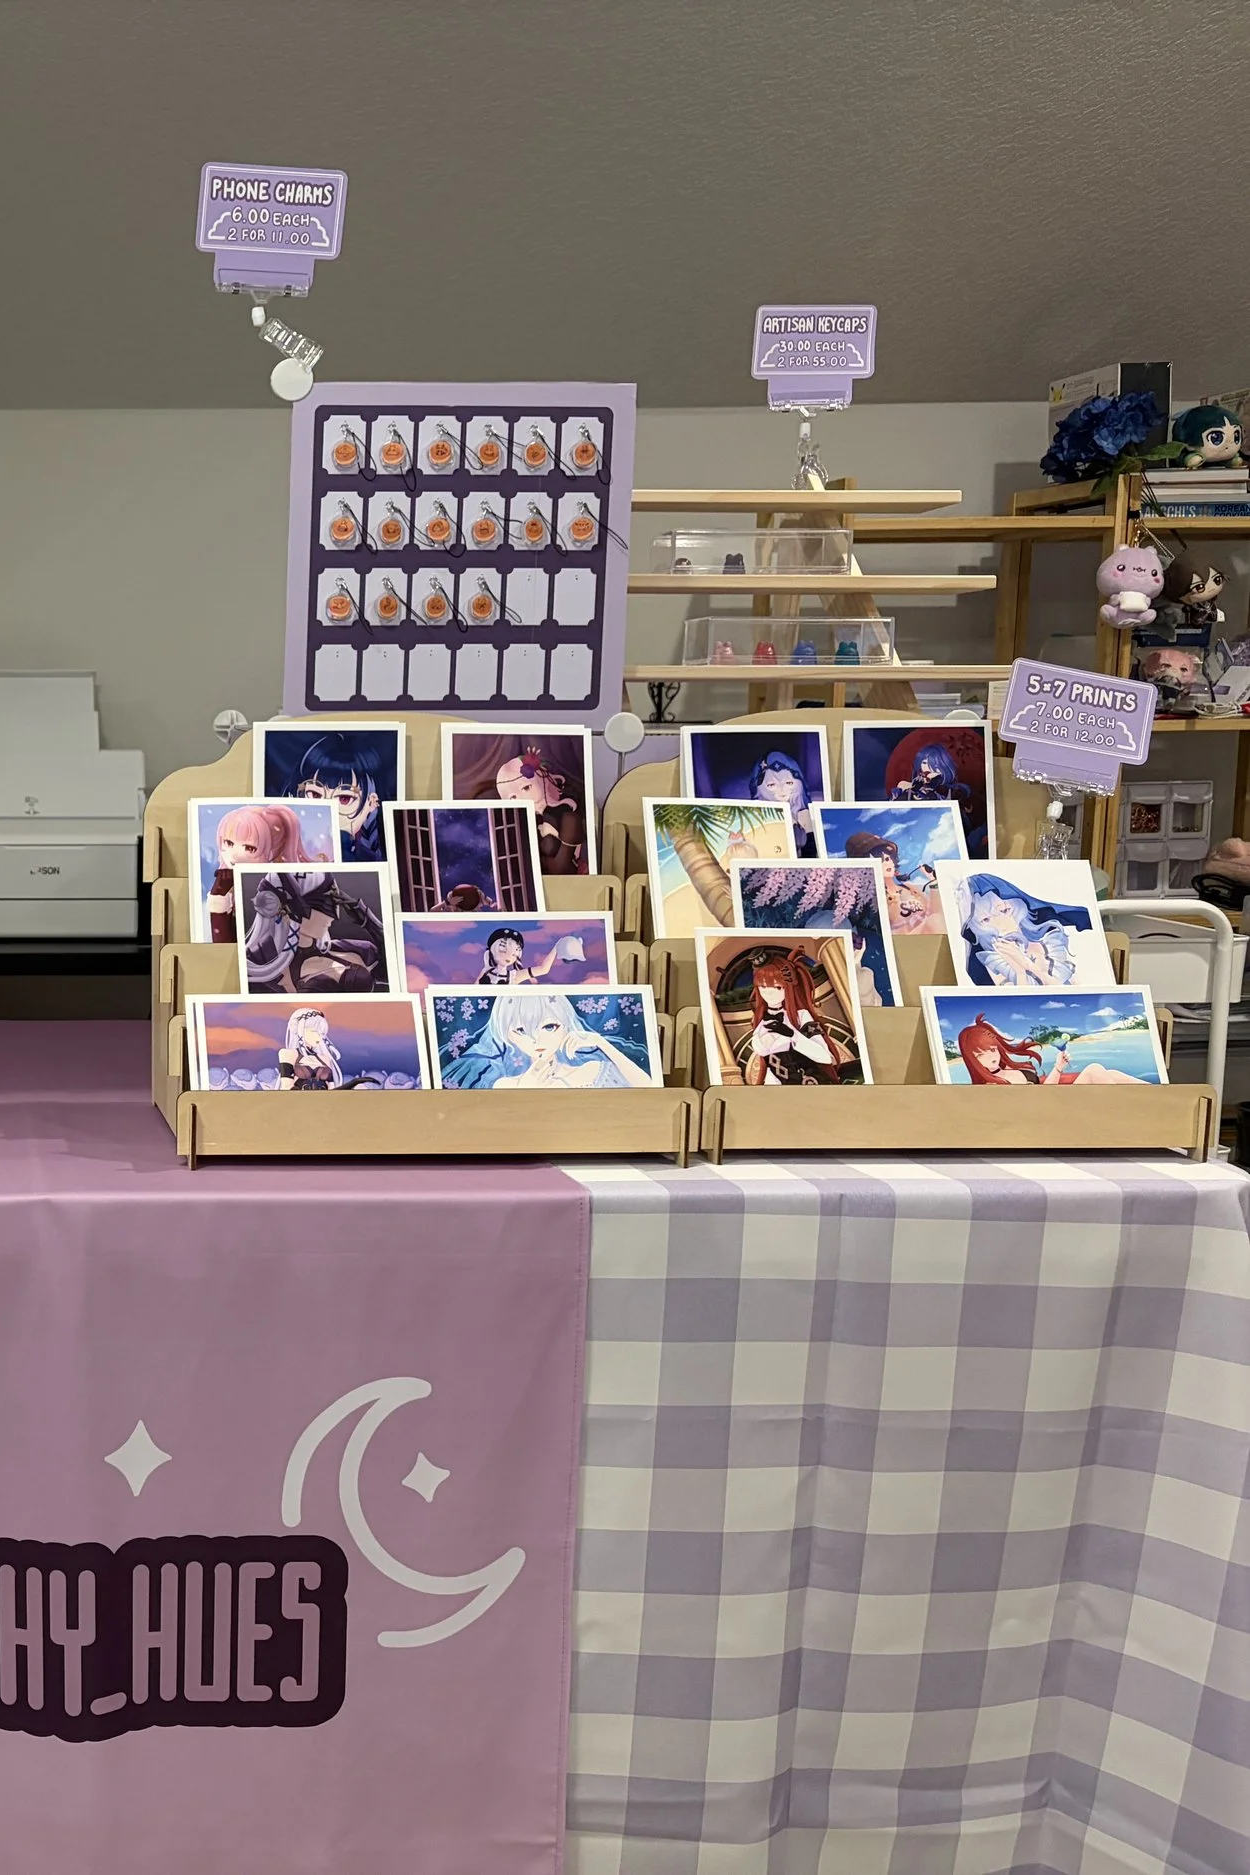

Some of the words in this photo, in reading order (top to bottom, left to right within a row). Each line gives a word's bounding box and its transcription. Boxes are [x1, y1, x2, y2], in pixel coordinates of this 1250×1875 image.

[211, 176, 270, 201] PHONE
[275, 180, 334, 207] CHARMS
[232, 206, 270, 224] 6.00
[273, 212, 310, 227] EACH
[227, 228, 237, 241] 2
[241, 229, 266, 241] FOR
[271, 231, 310, 245] 11.00
[763, 315, 814, 334] ARTISAN
[817, 315, 867, 334] KEYCAPS
[779, 340, 811, 354] 30.00
[815, 341, 846, 353] EACH
[777, 357, 786, 367] 2
[789, 356, 810, 367] FOR
[1070, 682, 1138, 712] PRINTS
[1036, 701, 1074, 721] 7.00
[1078, 712, 1116, 729] EACH
[1030, 720, 1039, 733] 2
[1044, 723, 1068, 738] FOR
[1075, 730, 1115, 746] 12.00
